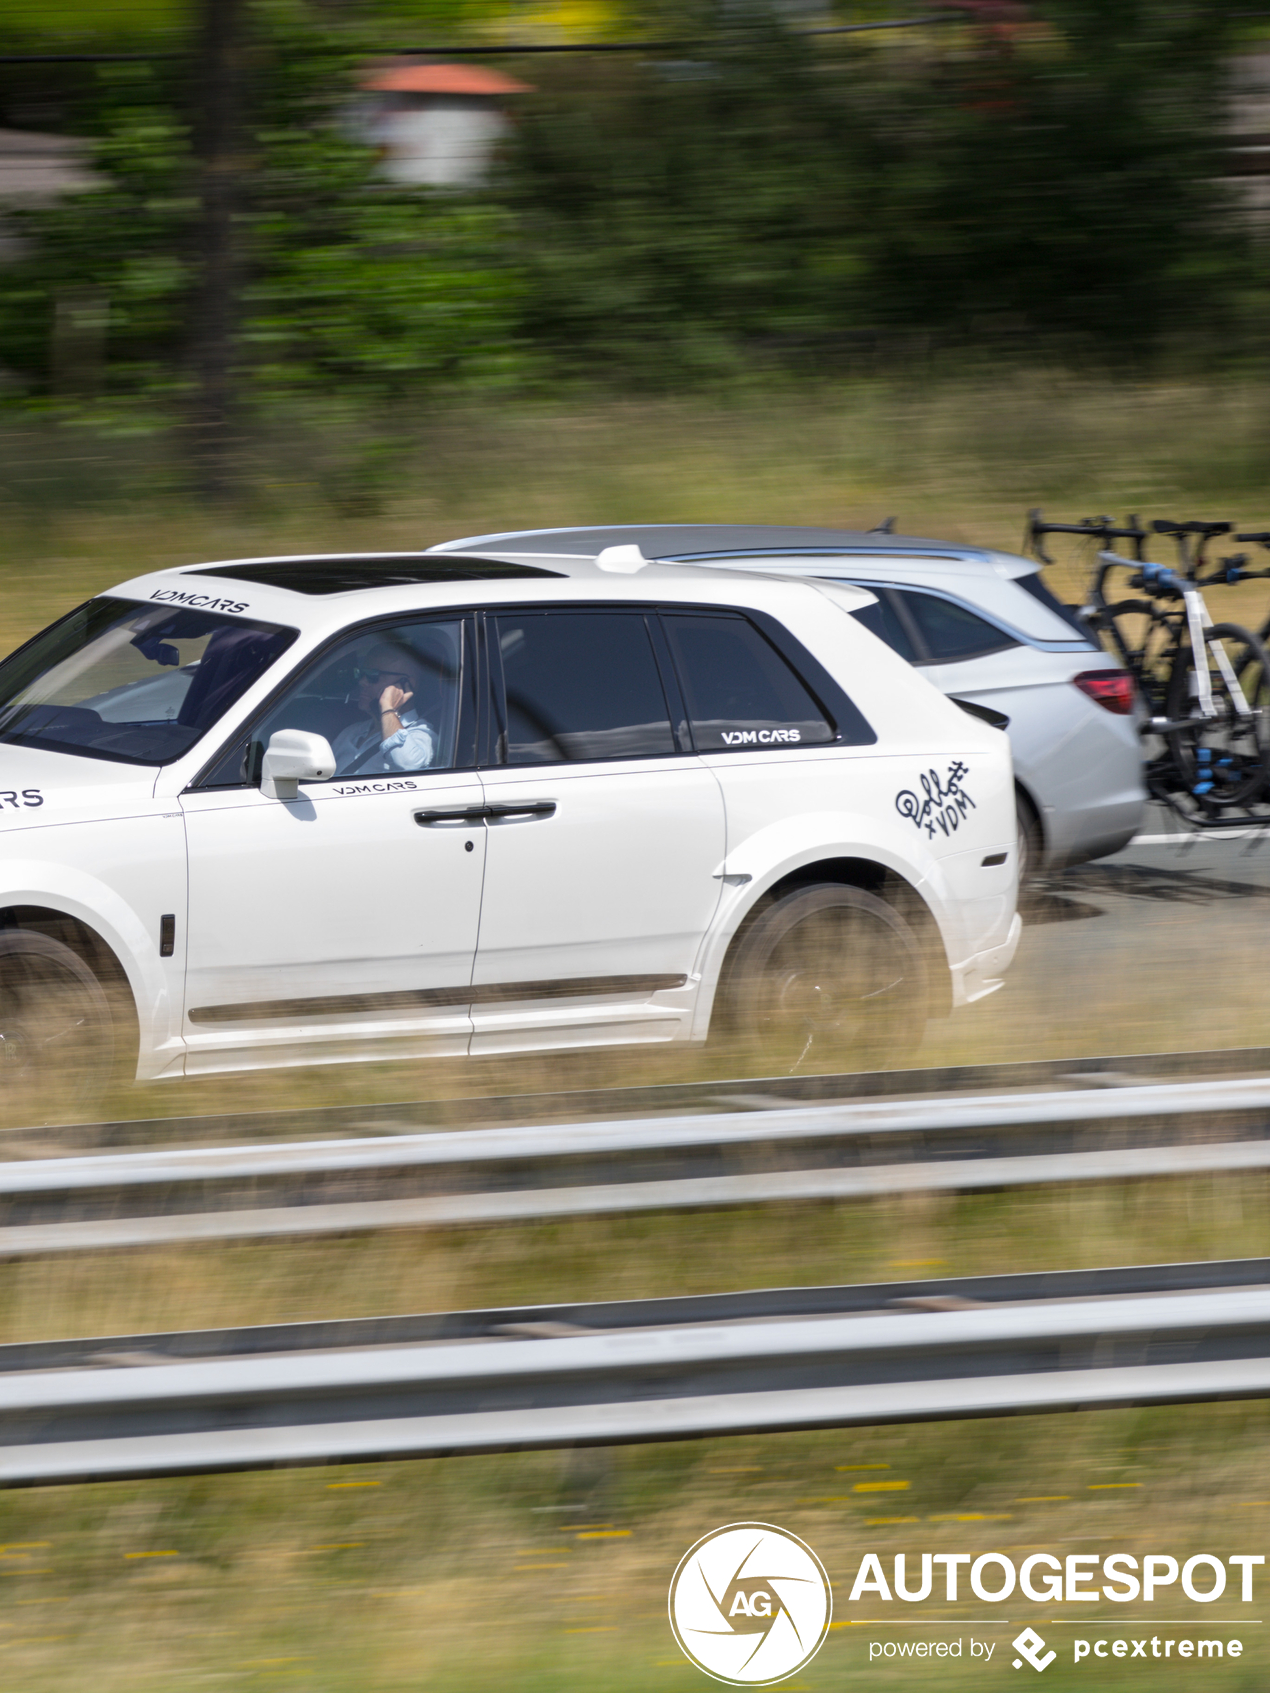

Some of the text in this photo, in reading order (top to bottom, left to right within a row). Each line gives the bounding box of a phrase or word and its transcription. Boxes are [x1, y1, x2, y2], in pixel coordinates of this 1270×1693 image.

[720, 728, 802, 745] VDM CARS
[332, 780, 418, 795] VDM CARS
[935, 788, 977, 837] VDM
